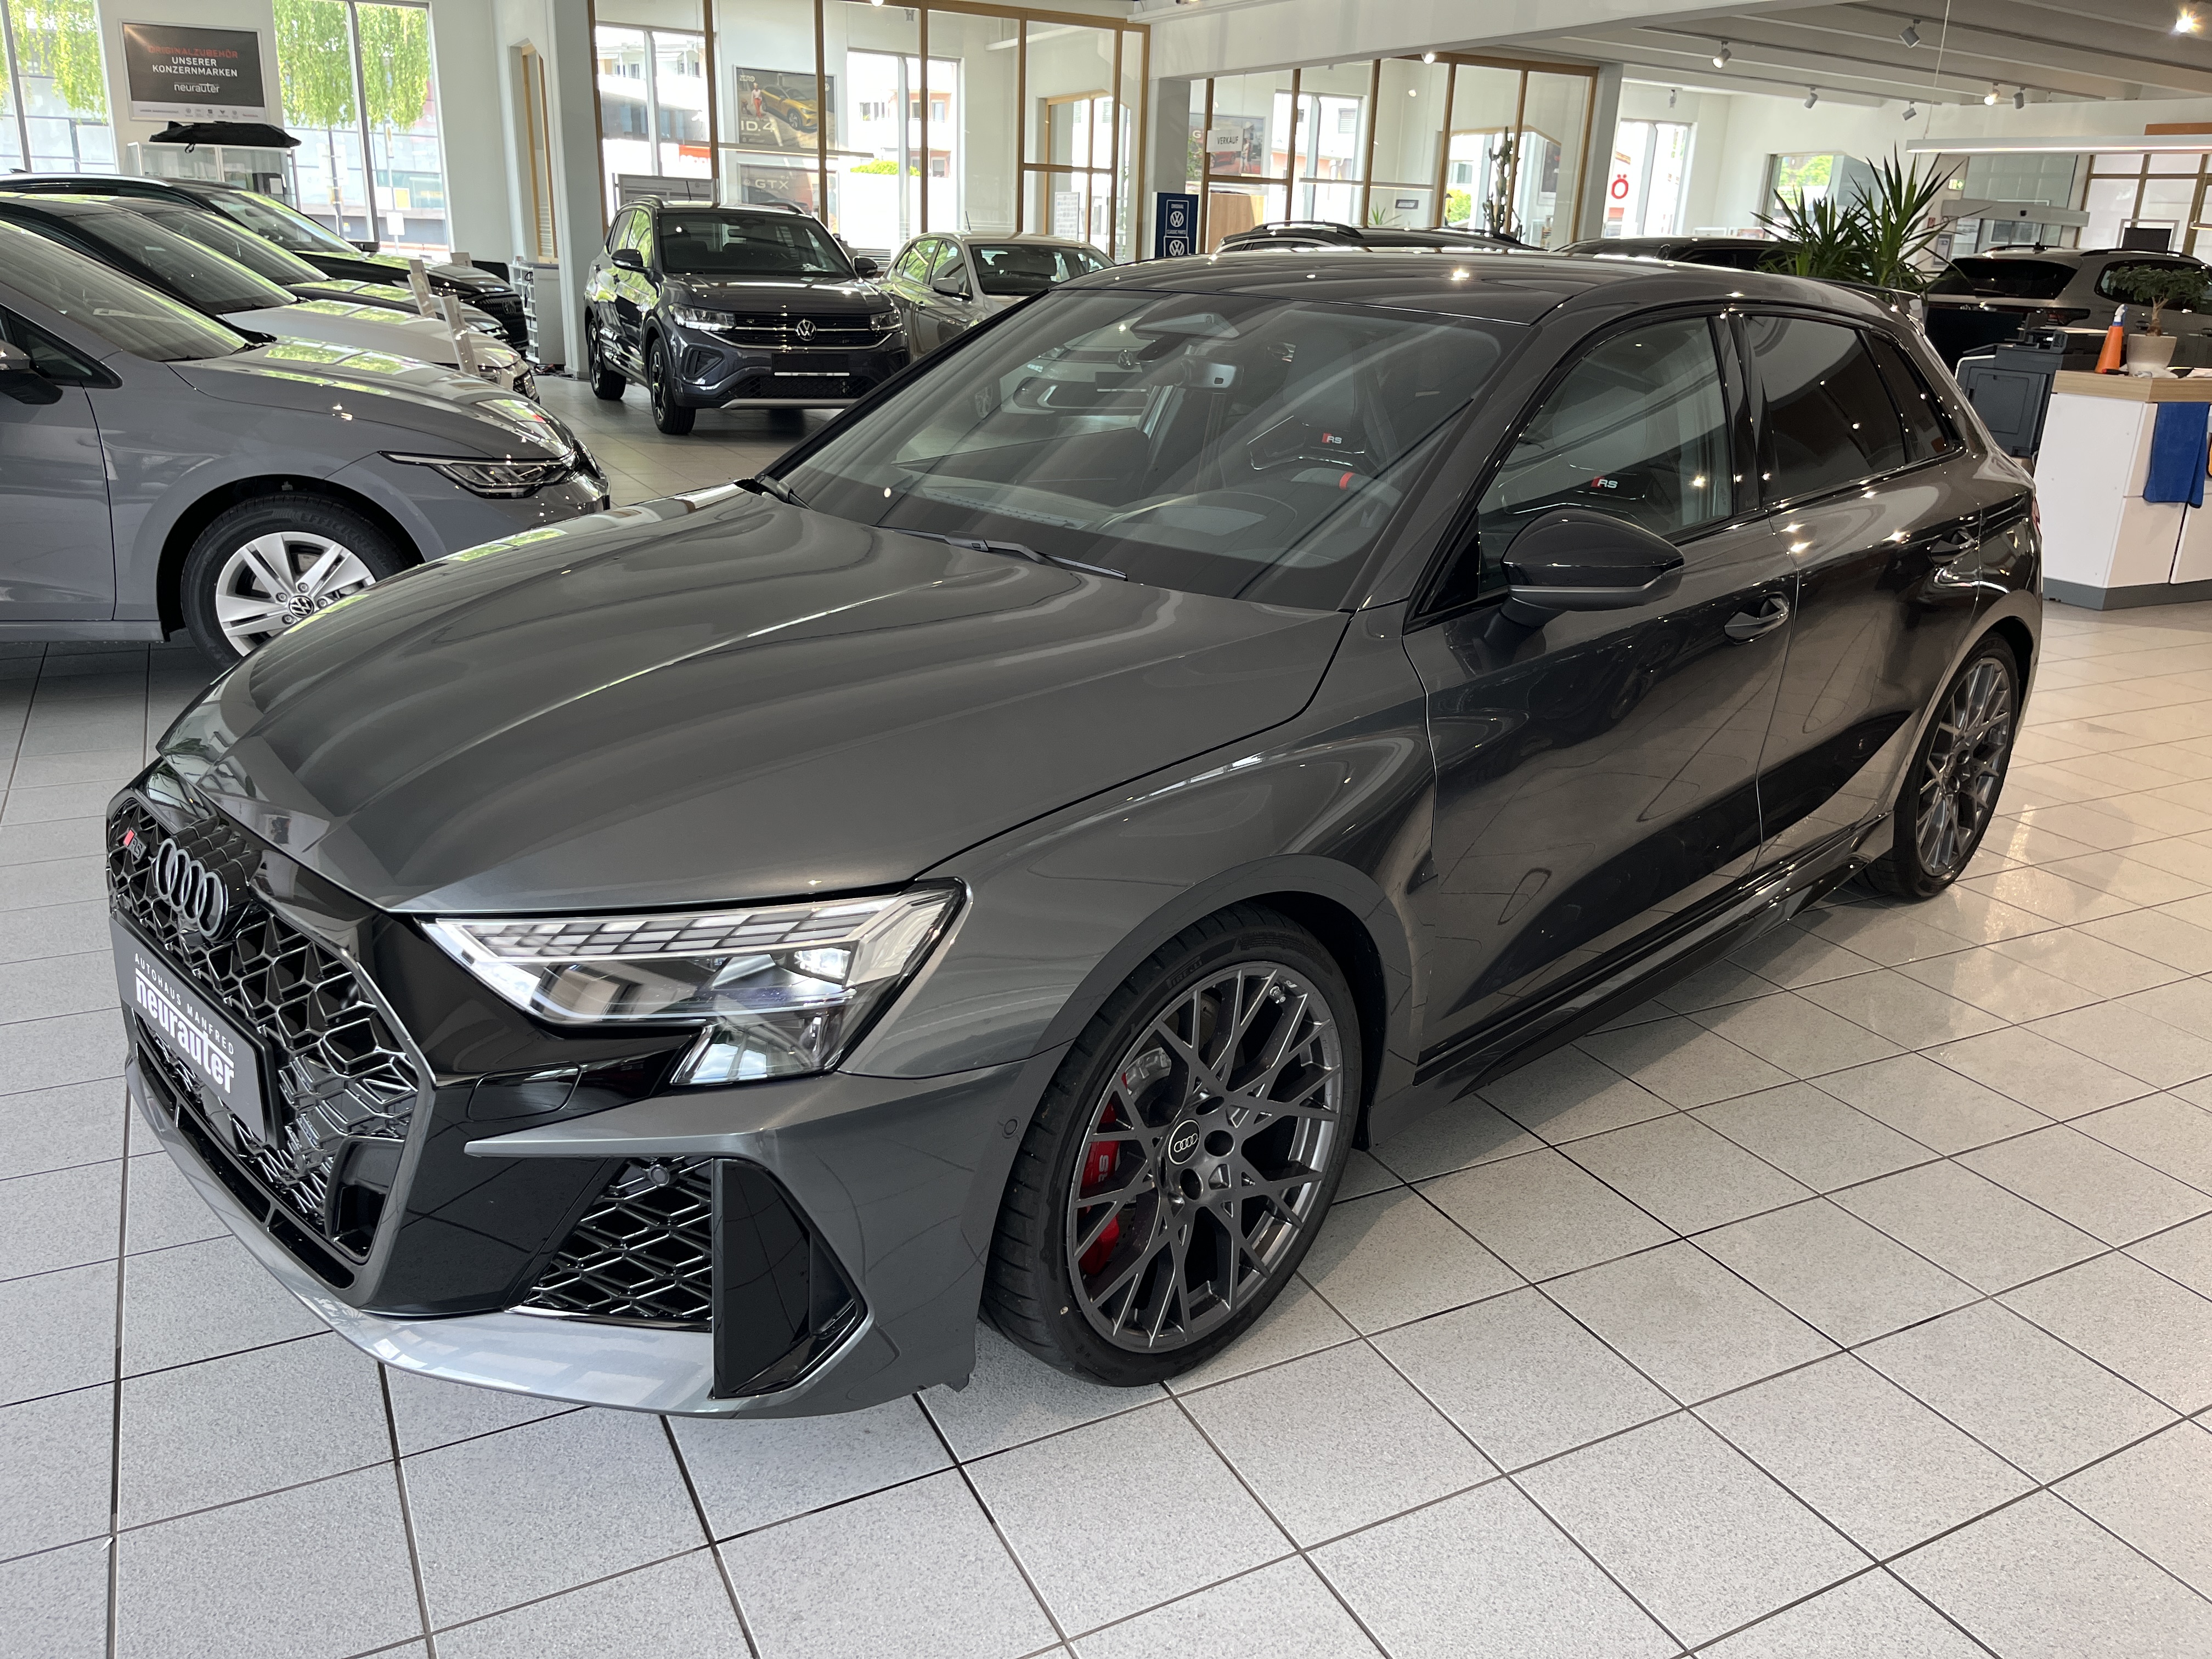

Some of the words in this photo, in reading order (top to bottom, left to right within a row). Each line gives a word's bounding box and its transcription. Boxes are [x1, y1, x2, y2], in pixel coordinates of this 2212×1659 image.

[172, 57, 217, 66] UNSERER
[153, 64, 238, 77] KONZERNMARKEN
[174, 83, 220, 93] neurauter
[1217, 136, 1239, 145] VERKAUF
[755, 179, 789, 190] GTX
[1326, 435, 1342, 444] RS
[1597, 478, 1618, 489] RS
[134, 953, 181, 1006] AUTOHAUS
[187, 1003, 234, 1056] MANFRED
[136, 974, 235, 1094] neurauter
